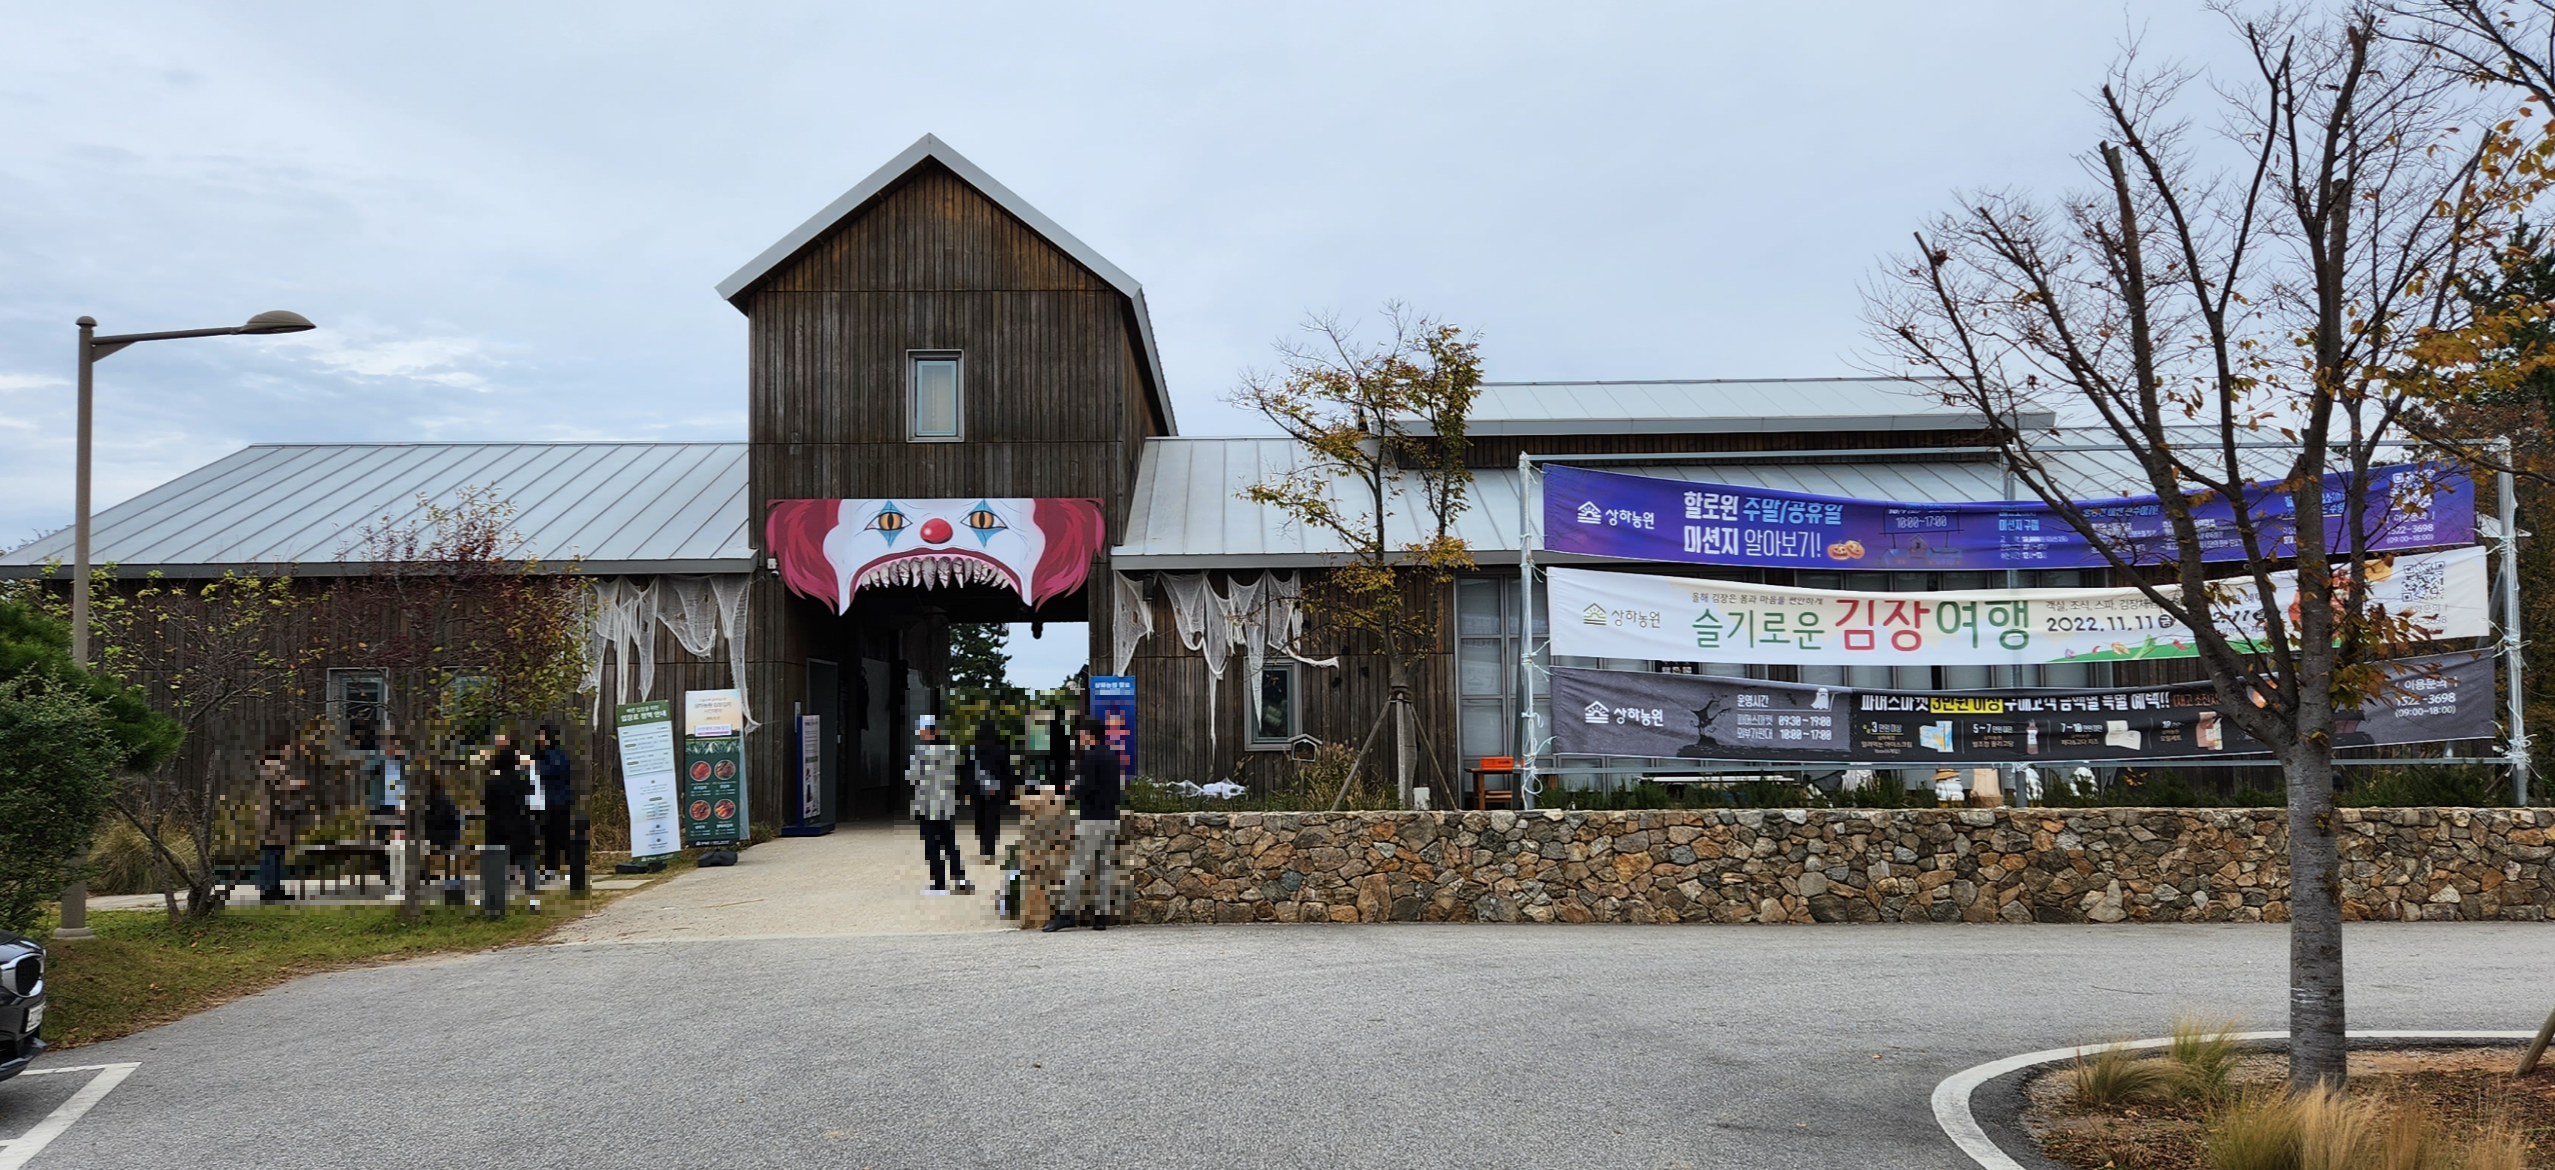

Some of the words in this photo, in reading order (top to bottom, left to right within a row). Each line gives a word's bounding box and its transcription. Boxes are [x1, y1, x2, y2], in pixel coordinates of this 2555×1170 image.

[1684, 491, 1739, 522] 할로윈
[1743, 496, 1844, 526] 주말/공휴일
[1605, 508, 1655, 530] 상하농원
[1684, 525, 1739, 556] 미션지
[1744, 529, 1822, 558] 알아보기!
[1692, 592, 1709, 604] 올해
[1712, 593, 1737, 605] 김장은
[1740, 594, 1758, 605] 몸과
[1760, 596, 1785, 606] 마음을
[1789, 597, 1824, 606] 편안하게
[1611, 610, 1661, 629] 상하농원
[1692, 609, 1826, 651] 슬기로운
[1737, 694, 1770, 708] 운영시간
[1613, 707, 1664, 726] 상하농원
[1737, 713, 1773, 727] 파머스마켓
